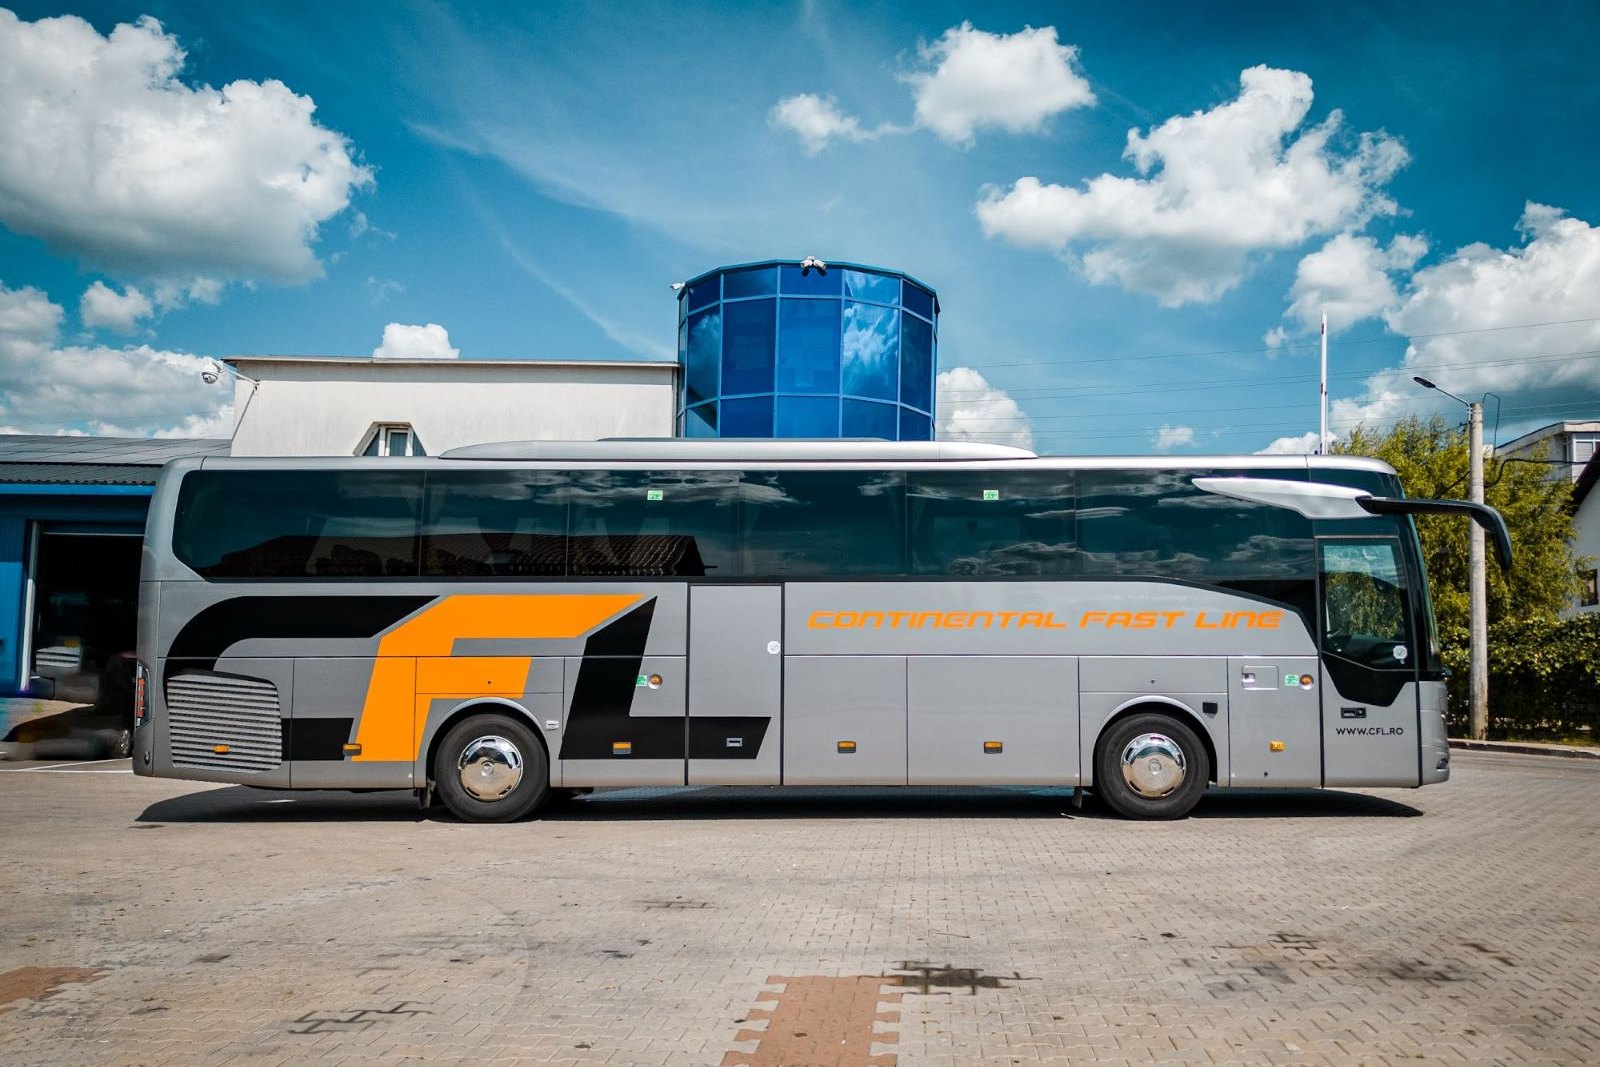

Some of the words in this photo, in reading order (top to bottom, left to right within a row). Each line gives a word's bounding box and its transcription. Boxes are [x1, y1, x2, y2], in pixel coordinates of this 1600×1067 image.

[807, 610, 1066, 630] CONTINENTAL
[1079, 610, 1185, 630] FAST
[1194, 610, 1285, 630] LINE
[1335, 727, 1404, 736] WWW.CFL.RO
